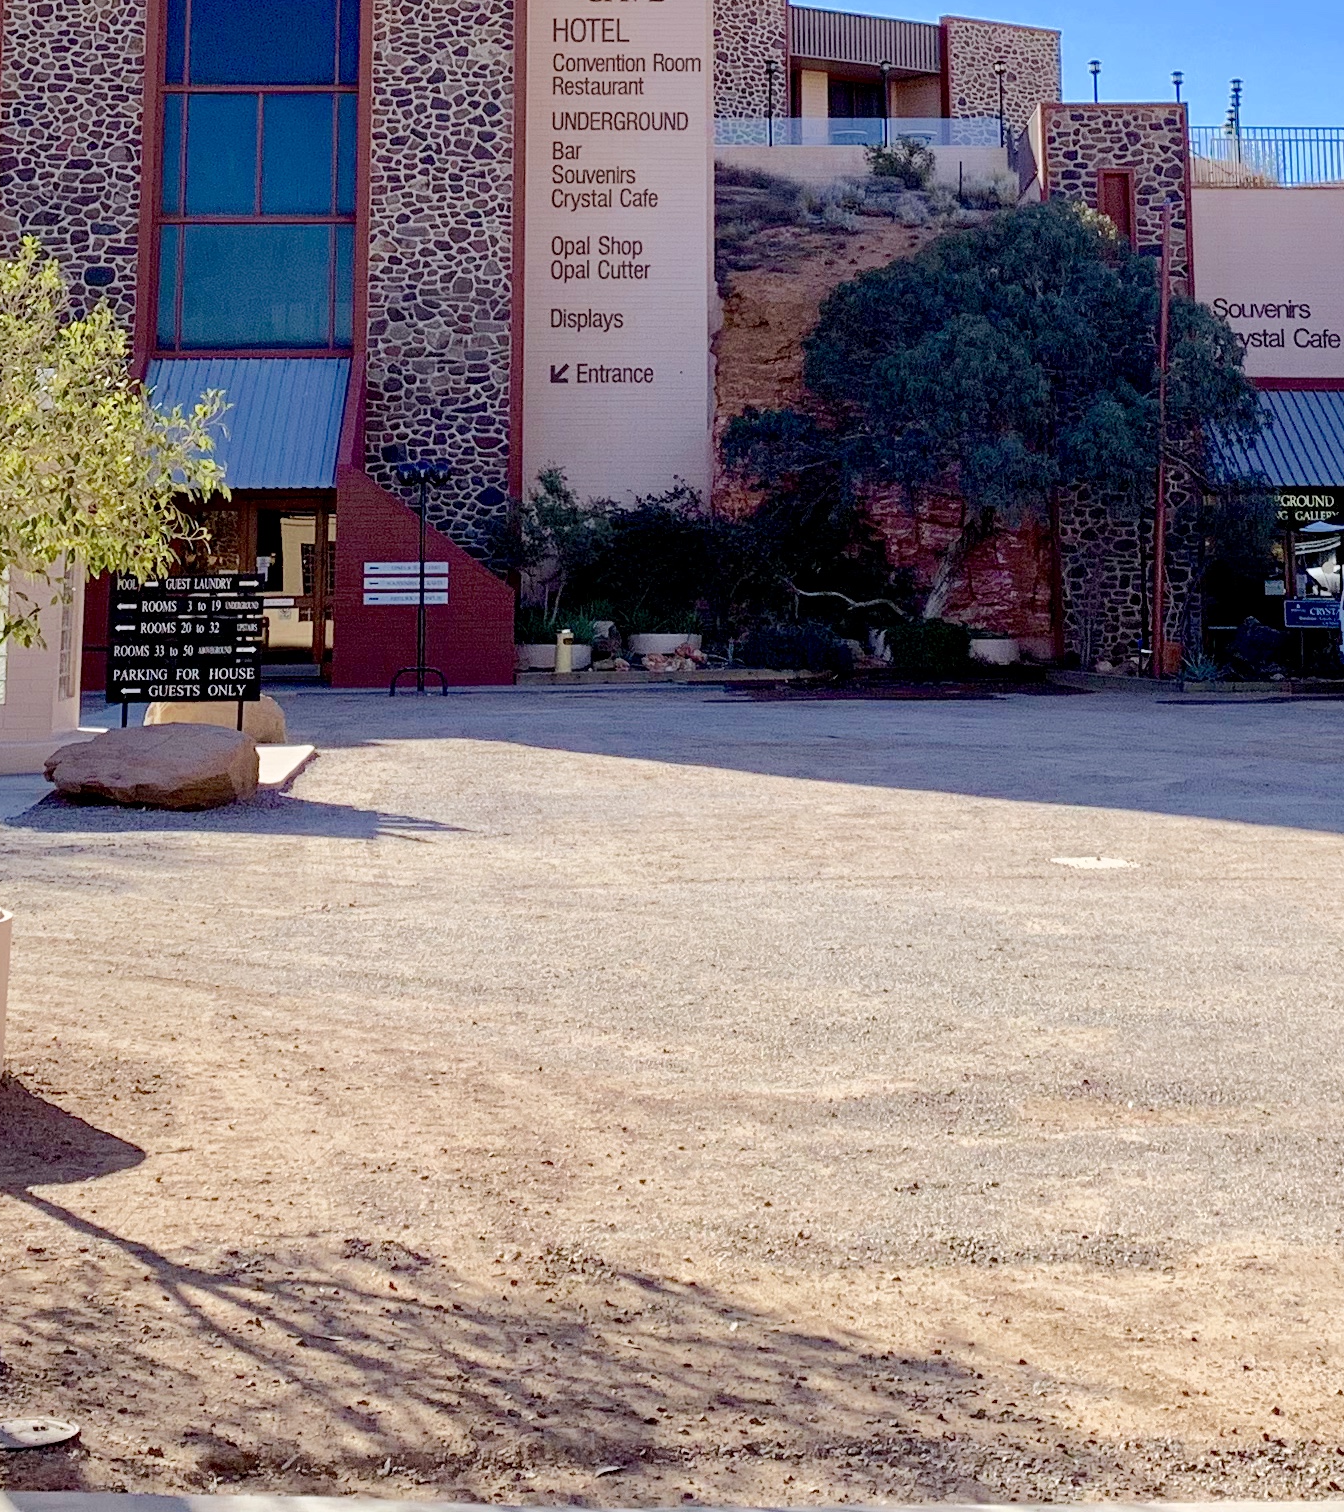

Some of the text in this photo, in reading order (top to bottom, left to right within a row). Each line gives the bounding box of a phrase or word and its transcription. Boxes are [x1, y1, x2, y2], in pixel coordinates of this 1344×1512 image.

[553, 18, 630, 43] HOTEL
[552, 53, 701, 72] Convention Room
[552, 77, 644, 95] Restaurant
[552, 111, 689, 131] UNDERGROUND
[552, 141, 582, 160] Bar
[552, 164, 636, 184] Souvenirs
[551, 188, 659, 212] Crystal Cafe
[551, 236, 643, 259] Opal Shop
[550, 259, 651, 283] Opal Cutter
[1213, 298, 1311, 319] Souvenirs
[550, 308, 624, 332] Displays
[1293, 328, 1341, 349] Cafe
[576, 363, 654, 383] Entrance
[165, 578, 191, 590] GUEST
[194, 577, 233, 590] LAUNDRY
[141, 600, 177, 612] ROOMS
[187, 601, 193, 612] 3
[197, 602, 206, 612] to
[211, 600, 221, 612] 19
[140, 622, 176, 634] ROOMS
[181, 622, 192, 634] 20
[196, 623, 205, 634] to
[209, 622, 220, 634] 32
[113, 645, 150, 657] ROOMS
[154, 645, 165, 657] 33
[169, 646, 178, 657] to
[183, 645, 194, 657] 50
[113, 667, 256, 681] PARKING FOR HOUSE
[148, 684, 247, 697] GUESTS ONLY
